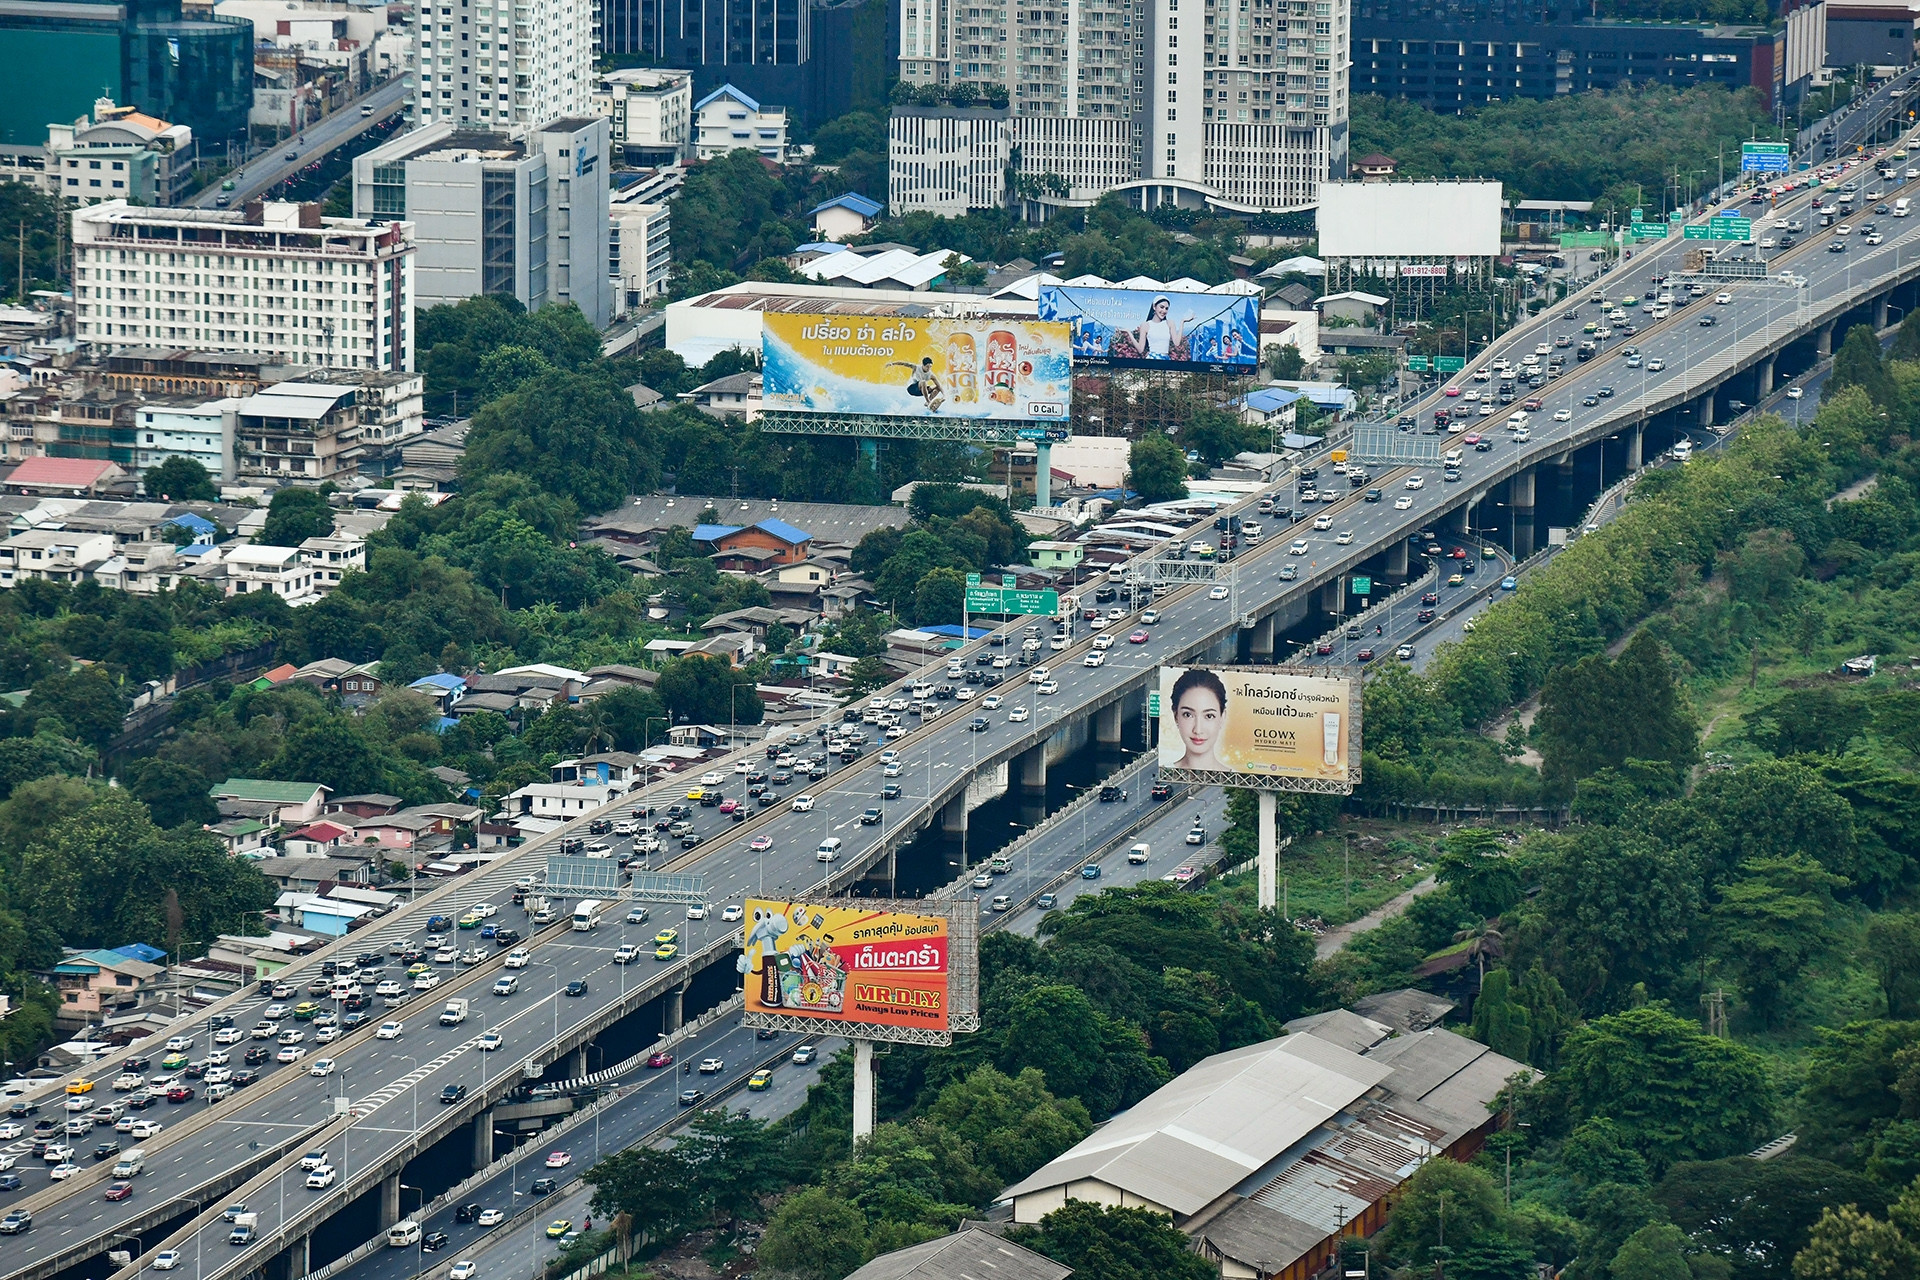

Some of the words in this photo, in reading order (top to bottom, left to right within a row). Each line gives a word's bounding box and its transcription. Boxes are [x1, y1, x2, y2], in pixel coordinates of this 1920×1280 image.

[1403, 266, 1447, 275] 081-912-8800
[801, 318, 851, 340] เปรี้ยว
[857, 324, 875, 341] ซ่า
[881, 322, 916, 341] สะใจ
[834, 344, 894, 357] แบบตัวเอง
[1033, 404, 1038, 413] 0
[1041, 404, 1058, 414] Cal.
[1276, 705, 1298, 717] แต้ว
[1253, 728, 1296, 740] GLOWX
[853, 922, 903, 939] ราคาสุดคุ้ม
[905, 924, 939, 936] ช้อปสนุก
[854, 943, 940, 968] เต็มตะกร้า
[855, 1003, 889, 1015] Always
[890, 1007, 909, 1016] Low
[910, 1008, 940, 1018] Prices
